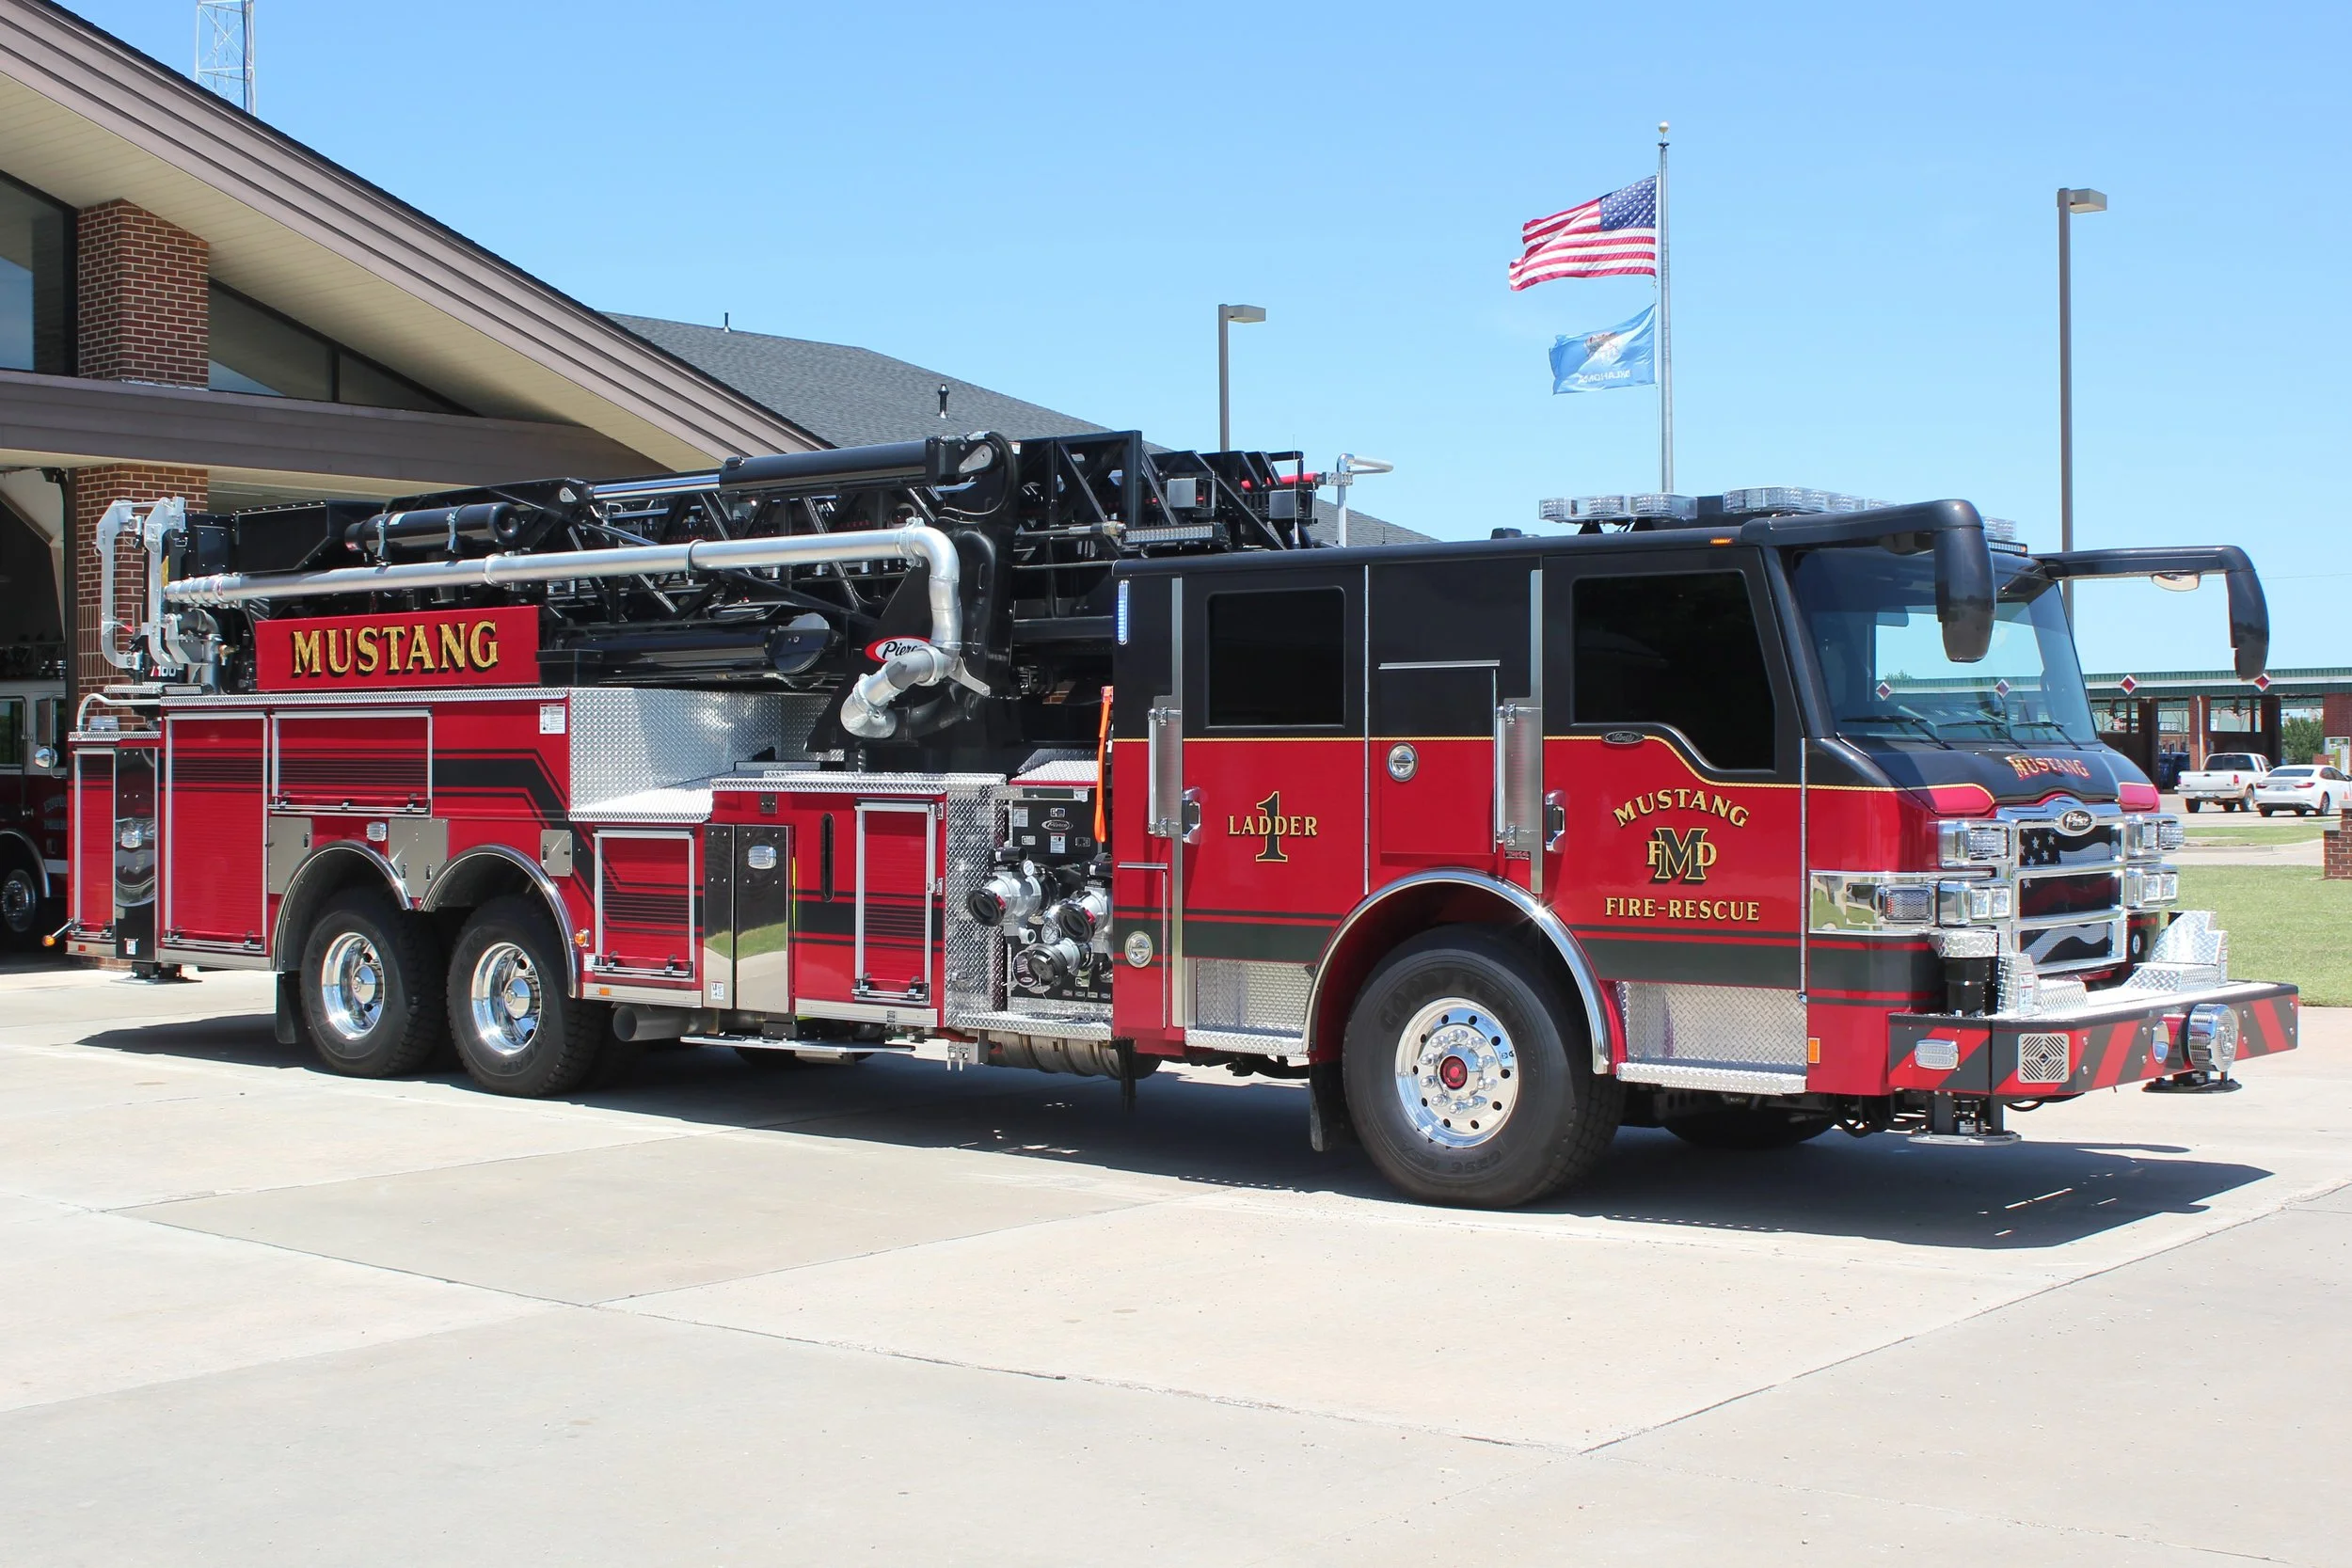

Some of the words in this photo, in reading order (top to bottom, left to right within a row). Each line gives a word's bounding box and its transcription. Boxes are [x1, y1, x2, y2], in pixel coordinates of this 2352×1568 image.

[291, 619, 500, 677] MUSTANG
[2009, 757, 2090, 780] MUSTANG
[1613, 788, 1750, 829] MUSTANG
[1227, 815, 1318, 837] LADDER
[1255, 790, 1289, 863] 1
[1605, 897, 1760, 922] FIRE-RESCUE
